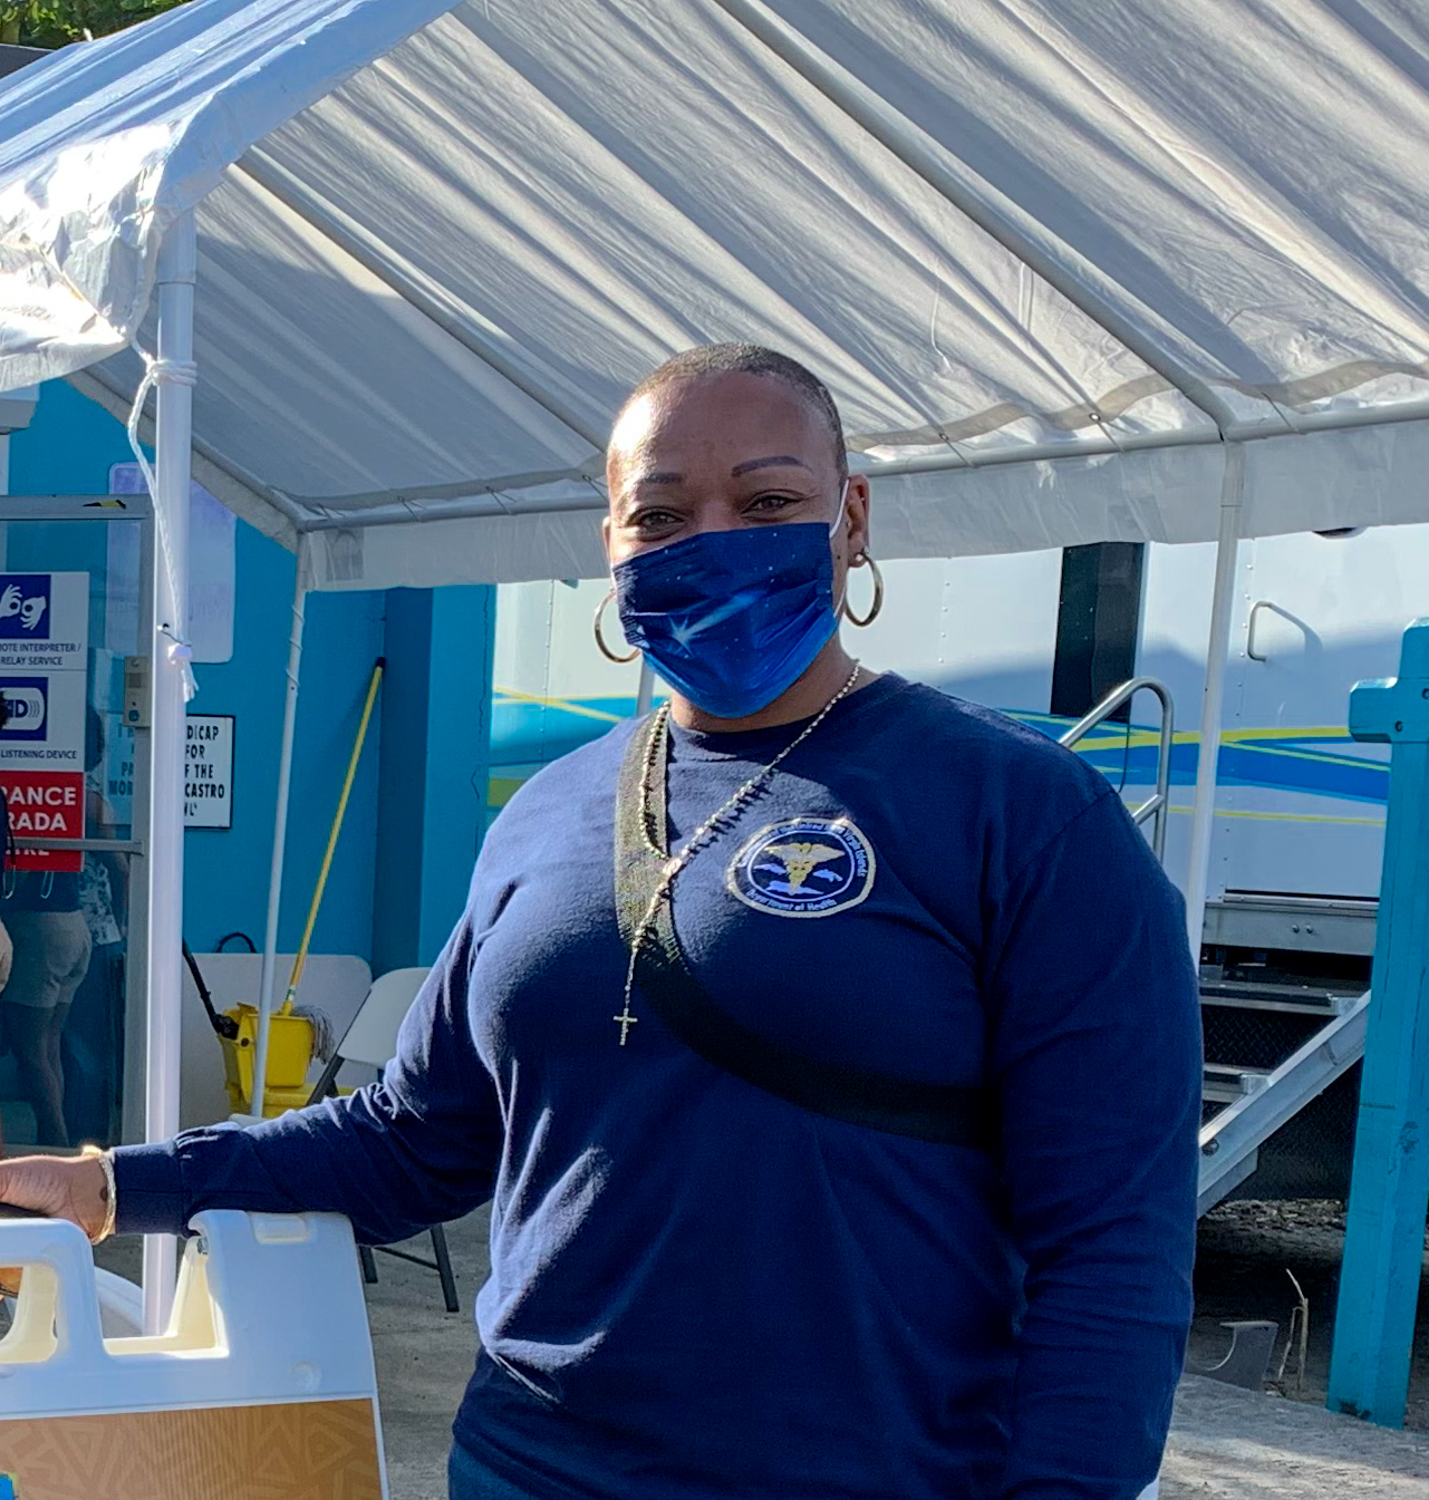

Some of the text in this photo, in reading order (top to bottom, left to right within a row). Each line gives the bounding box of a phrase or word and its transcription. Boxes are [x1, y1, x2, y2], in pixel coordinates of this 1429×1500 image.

[20, 643, 76, 652] INTERPRETER
[0, 656, 26, 665] RELAY
[28, 657, 63, 666] SERVICE
[187, 724, 220, 740] DICAP
[0, 749, 45, 759] LISTENING
[46, 750, 77, 759] DEVICE
[195, 764, 214, 779] THE
[185, 783, 225, 799] CASTRO
[8, 811, 68, 831] RADA
